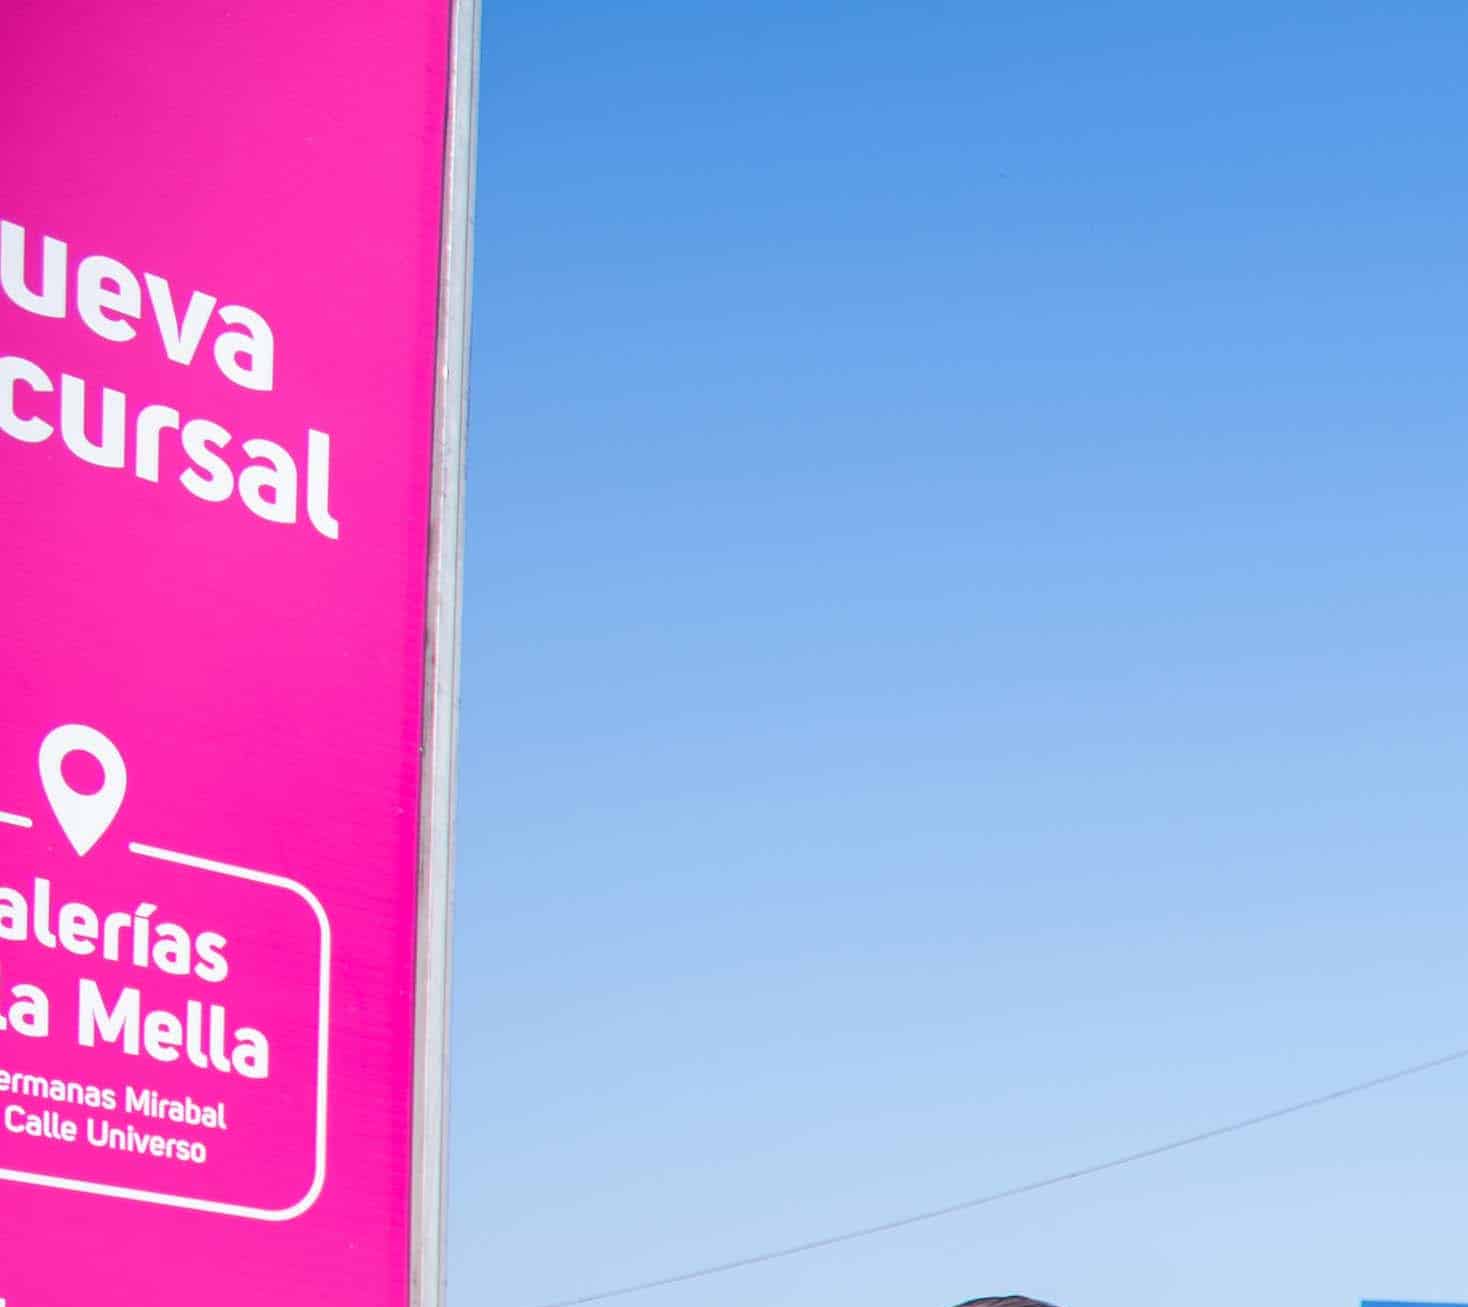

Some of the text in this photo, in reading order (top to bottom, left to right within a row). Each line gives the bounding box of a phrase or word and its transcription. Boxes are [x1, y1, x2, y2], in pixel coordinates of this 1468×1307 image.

[0, 355, 340, 541] cursal
[77, 977, 270, 1080] Mella
[4, 1104, 207, 1164] Calle Universo
[124, 1085, 228, 1131] Mirabal
